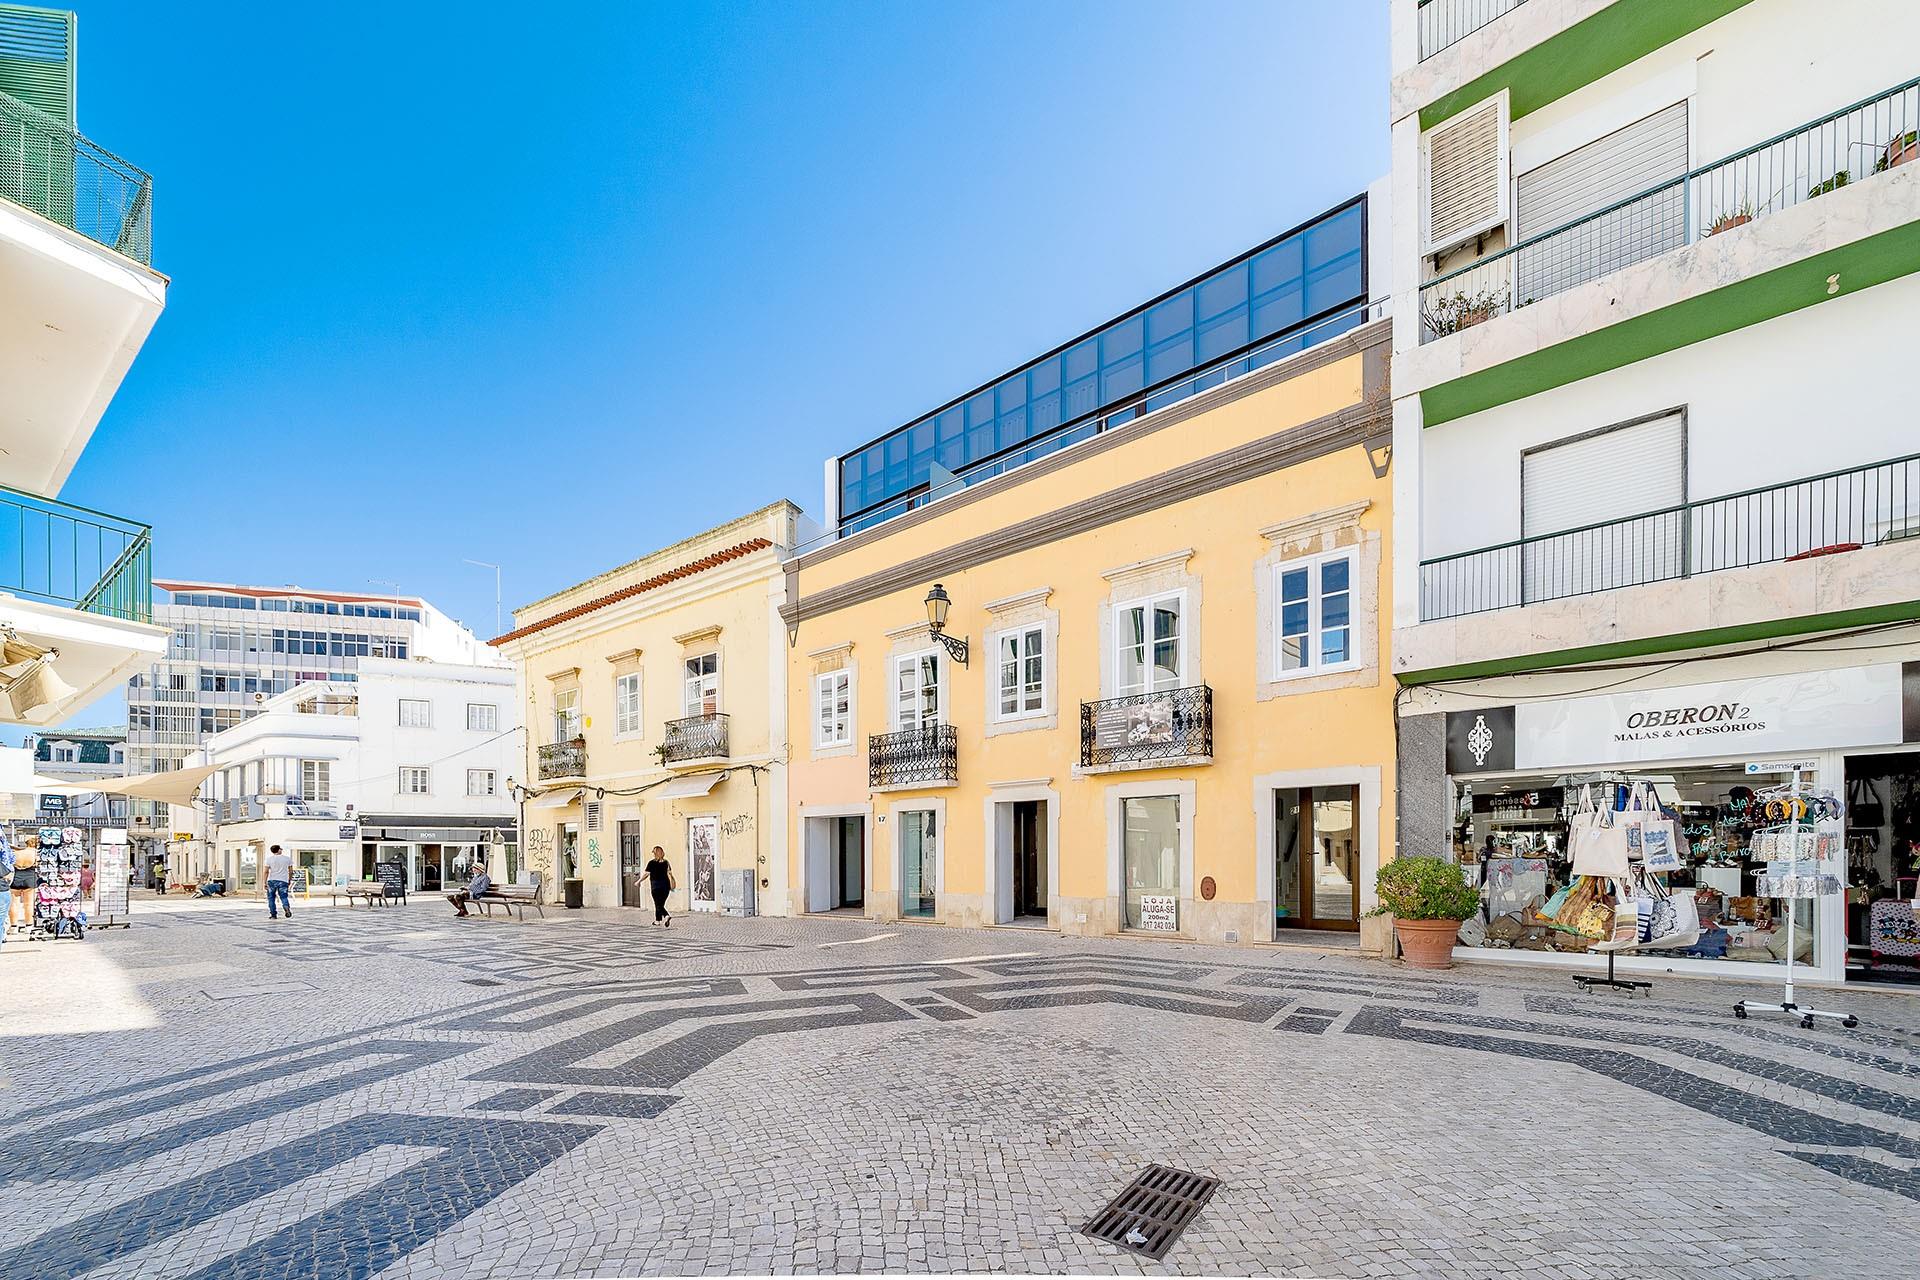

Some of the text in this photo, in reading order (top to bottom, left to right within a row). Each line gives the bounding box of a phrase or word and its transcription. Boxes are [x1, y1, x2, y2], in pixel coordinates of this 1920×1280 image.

[1626, 703, 1750, 729] OBERON 2
[1614, 721, 1766, 742] MALAS & ACESSÓRIOS
[1142, 905, 1174, 913] ALUGA-SE
[1143, 921, 1174, 930] 917 242 024
